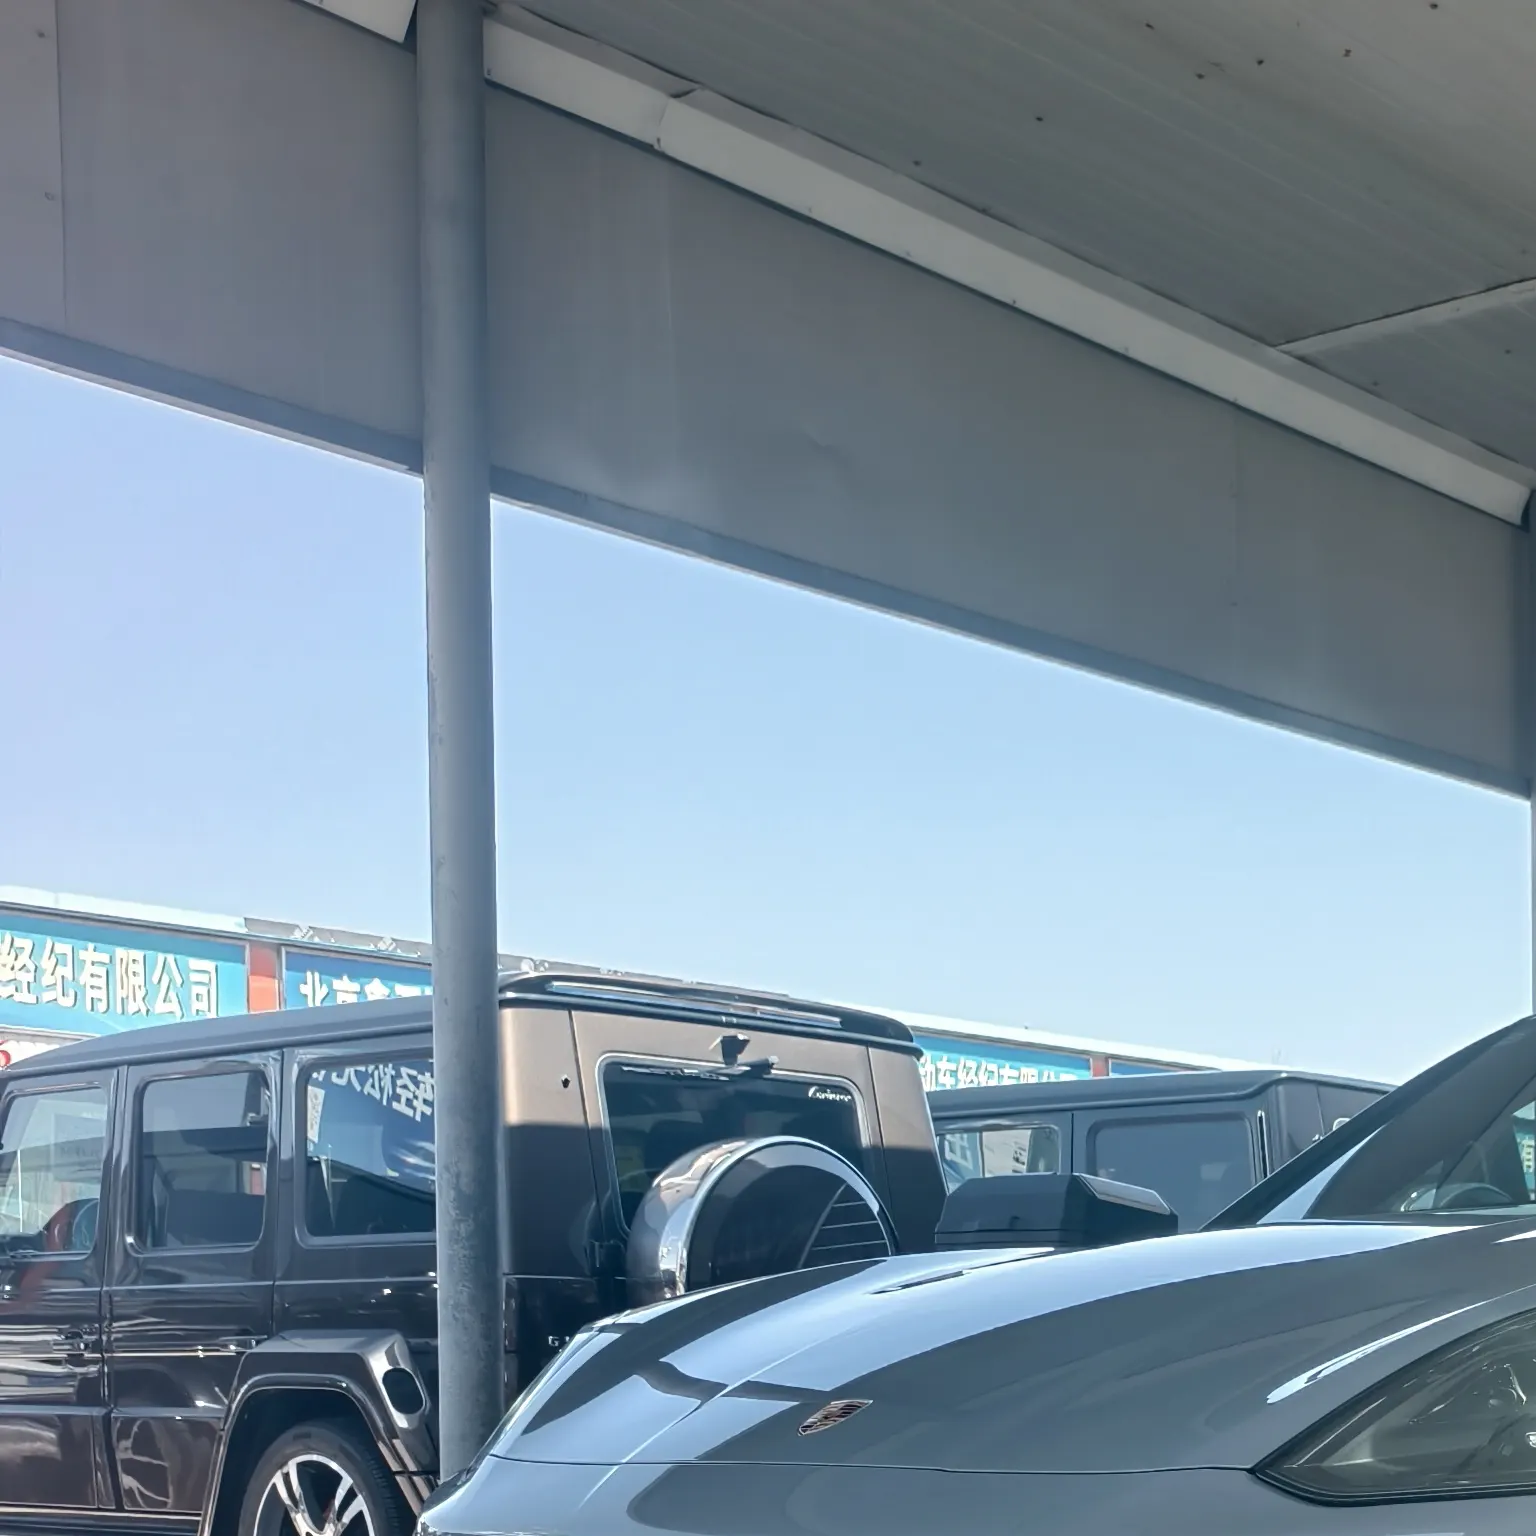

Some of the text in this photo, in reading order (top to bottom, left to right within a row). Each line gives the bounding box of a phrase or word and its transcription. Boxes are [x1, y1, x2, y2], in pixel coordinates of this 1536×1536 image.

[0, 931, 218, 1020] 经纪有限公司
